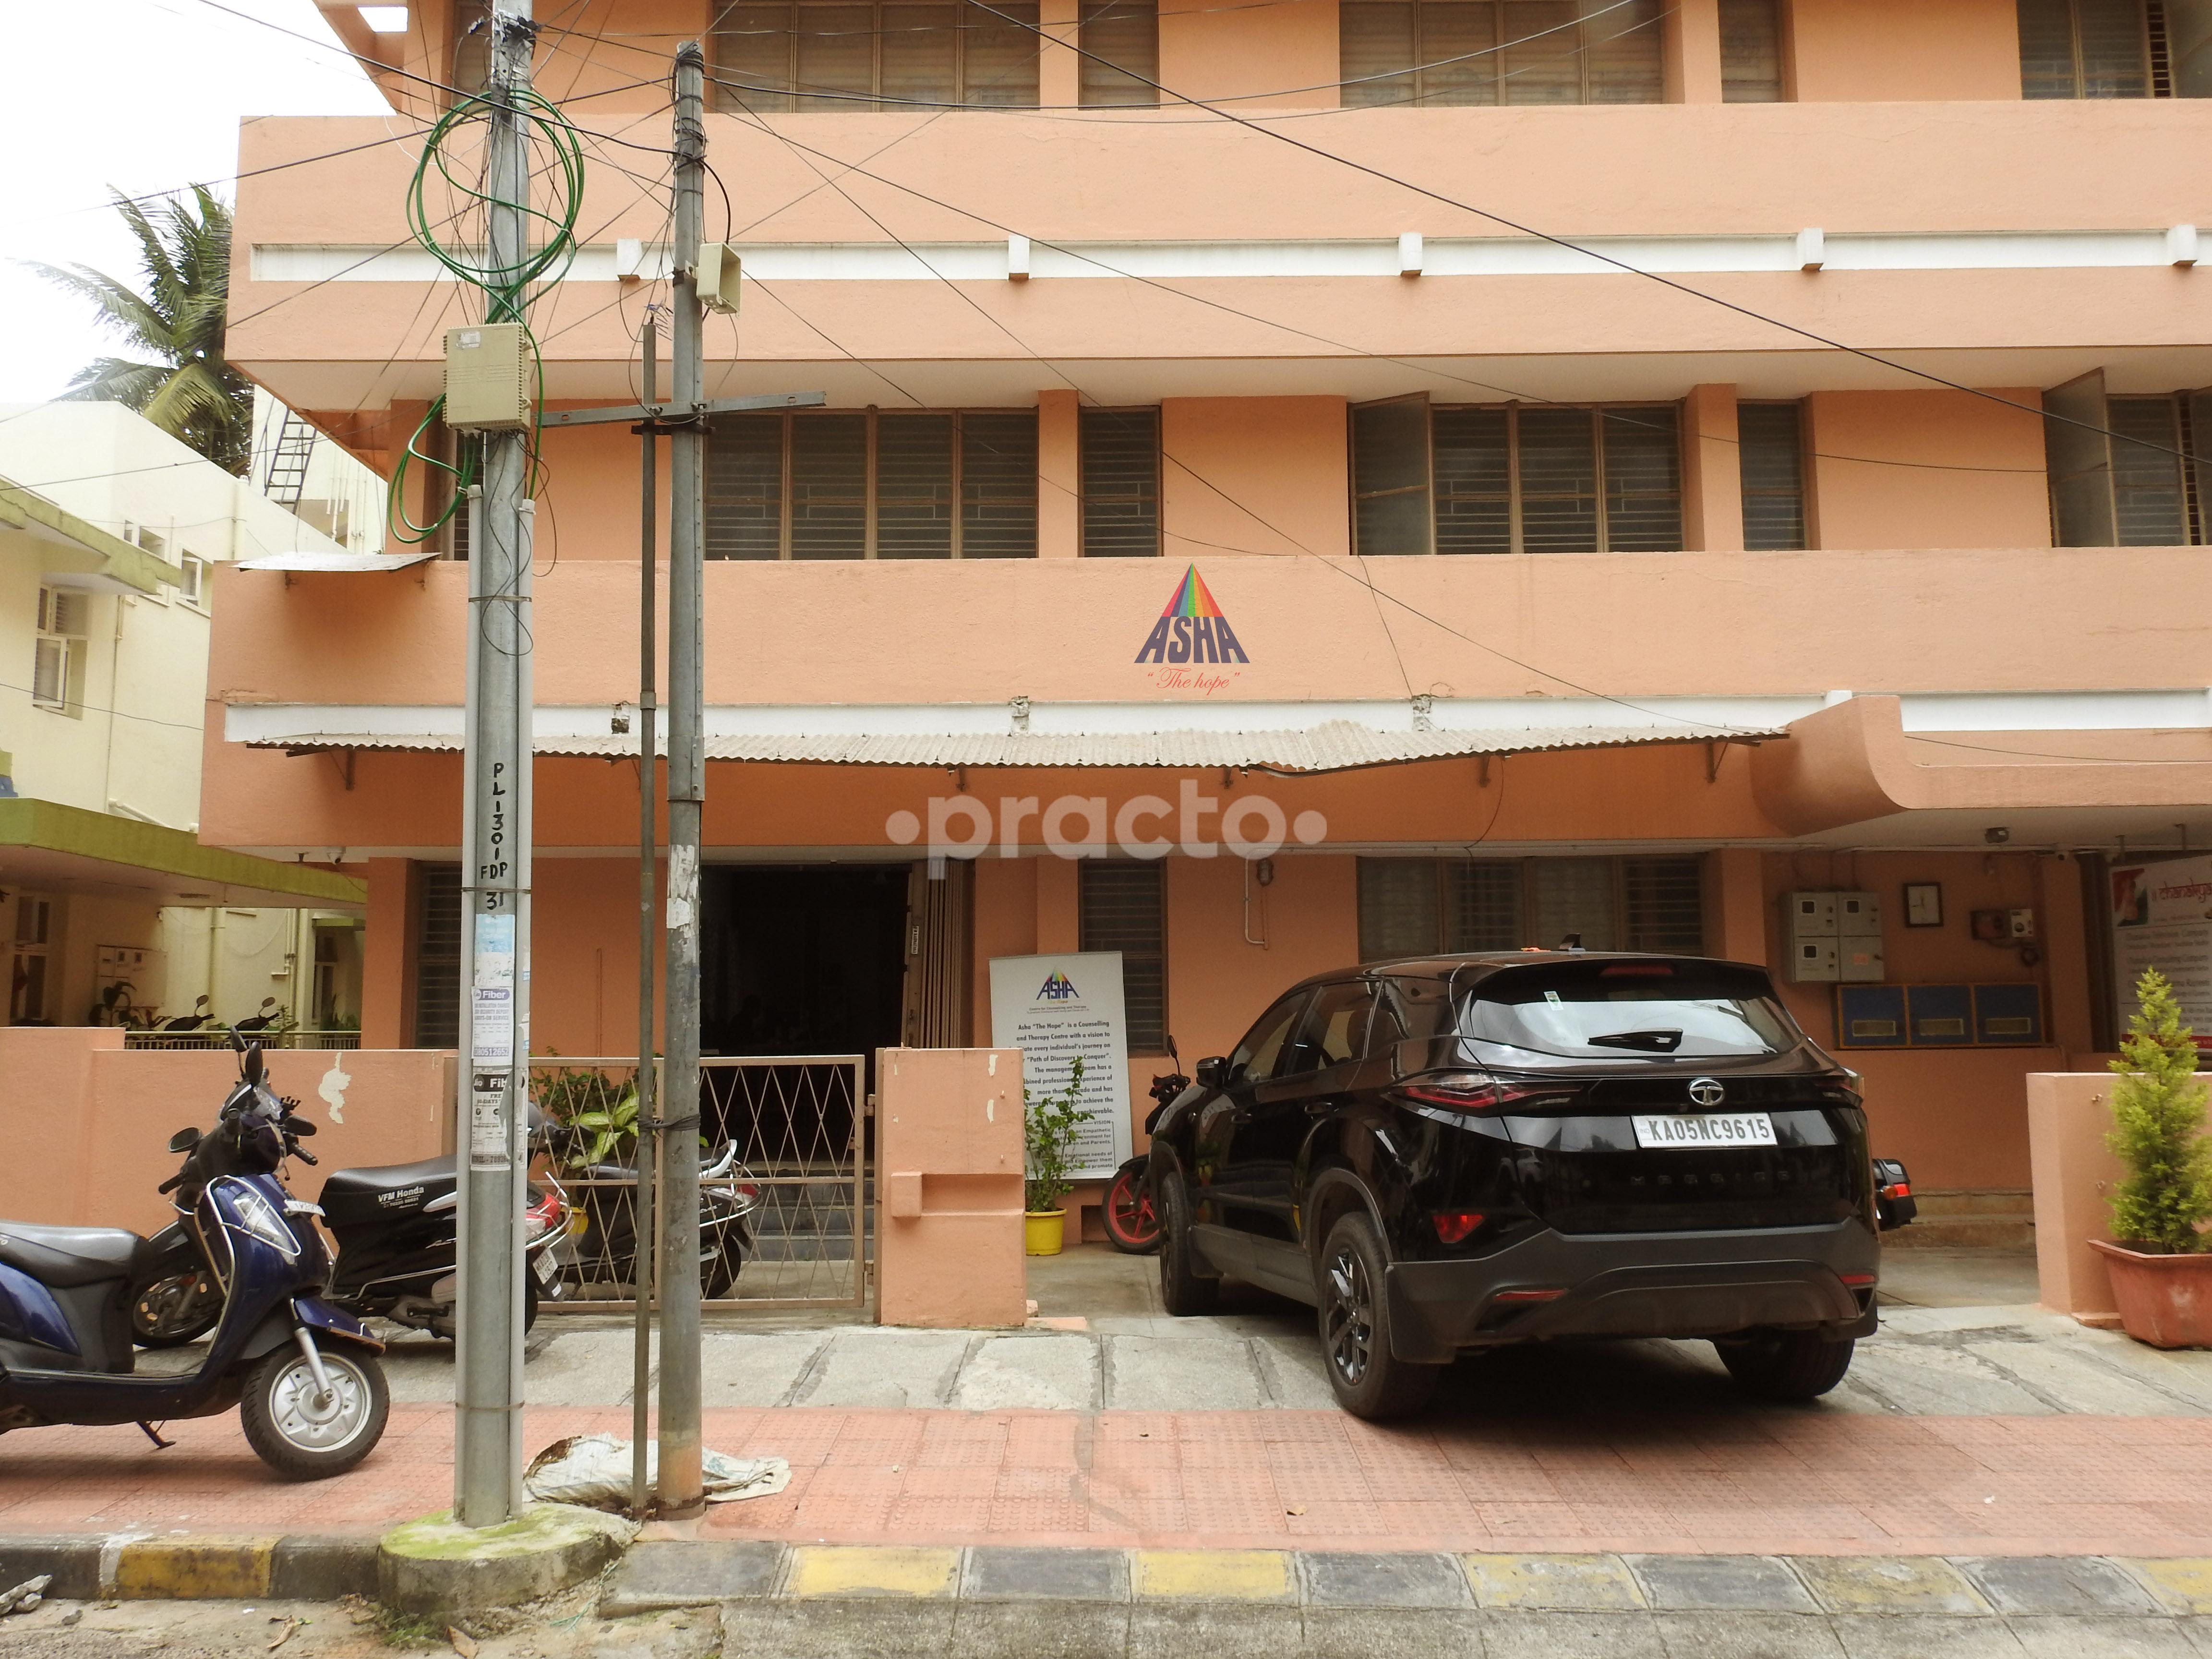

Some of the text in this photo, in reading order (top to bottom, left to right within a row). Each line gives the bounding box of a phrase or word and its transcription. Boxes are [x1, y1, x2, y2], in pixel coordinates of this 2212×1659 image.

[1134, 616, 1250, 663] ASHA
[481, 862, 508, 879] FDP
[482, 990, 506, 998] Fiber
[1036, 981, 1079, 1000] ASHA
[1648, 1118, 1770, 1141] KA05NC9615
[378, 1186, 424, 1202] VFM Honda
